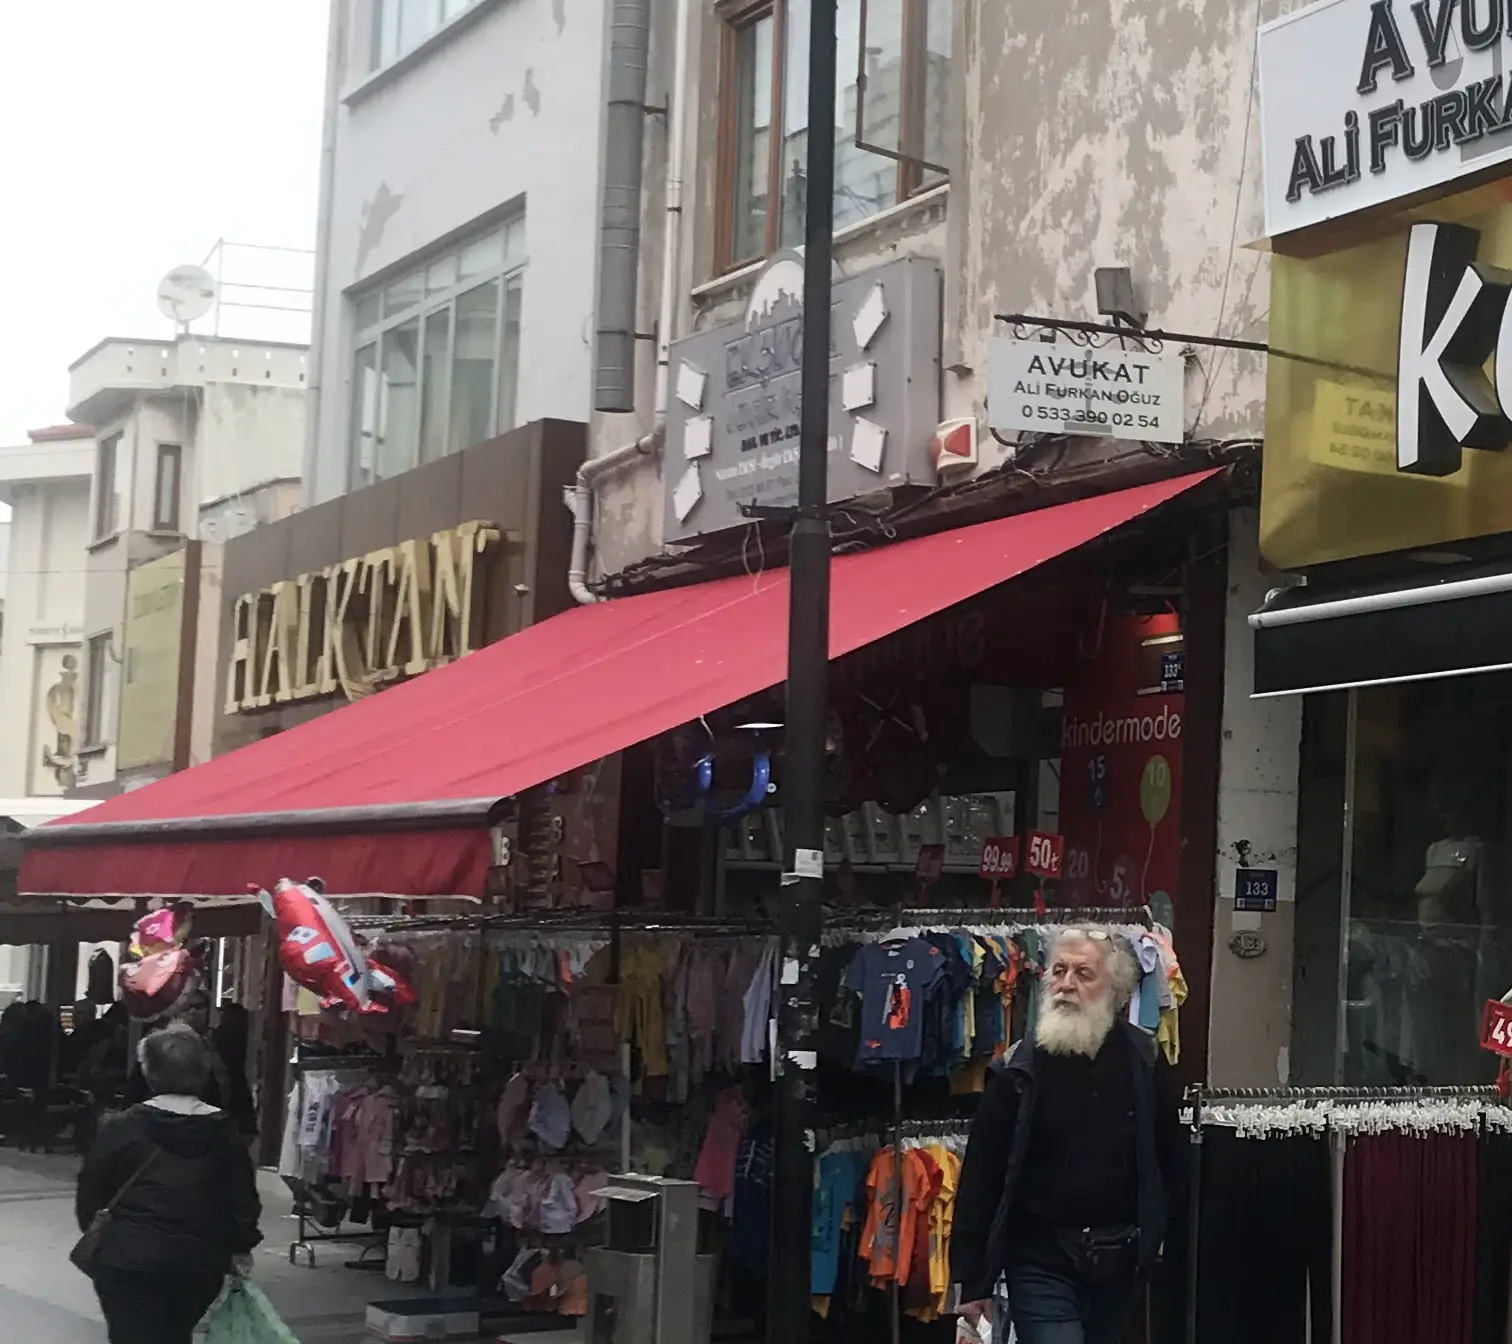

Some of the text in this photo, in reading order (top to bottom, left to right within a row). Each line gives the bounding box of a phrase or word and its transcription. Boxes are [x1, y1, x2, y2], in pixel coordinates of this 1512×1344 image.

[1285, 109, 1362, 203] ALİ
[1027, 354, 1151, 384] AVUKAT
[1013, 380, 1162, 406] ALİ FURKAN OĞUZ
[1022, 405, 1161, 428] 0 533 390 02 54
[224, 519, 506, 715] HALKTAN
[1061, 705, 1182, 748] kindermode
[1087, 756, 1106, 781] 15
[1067, 850, 1090, 878] 20
[1246, 881, 1269, 896] 133
